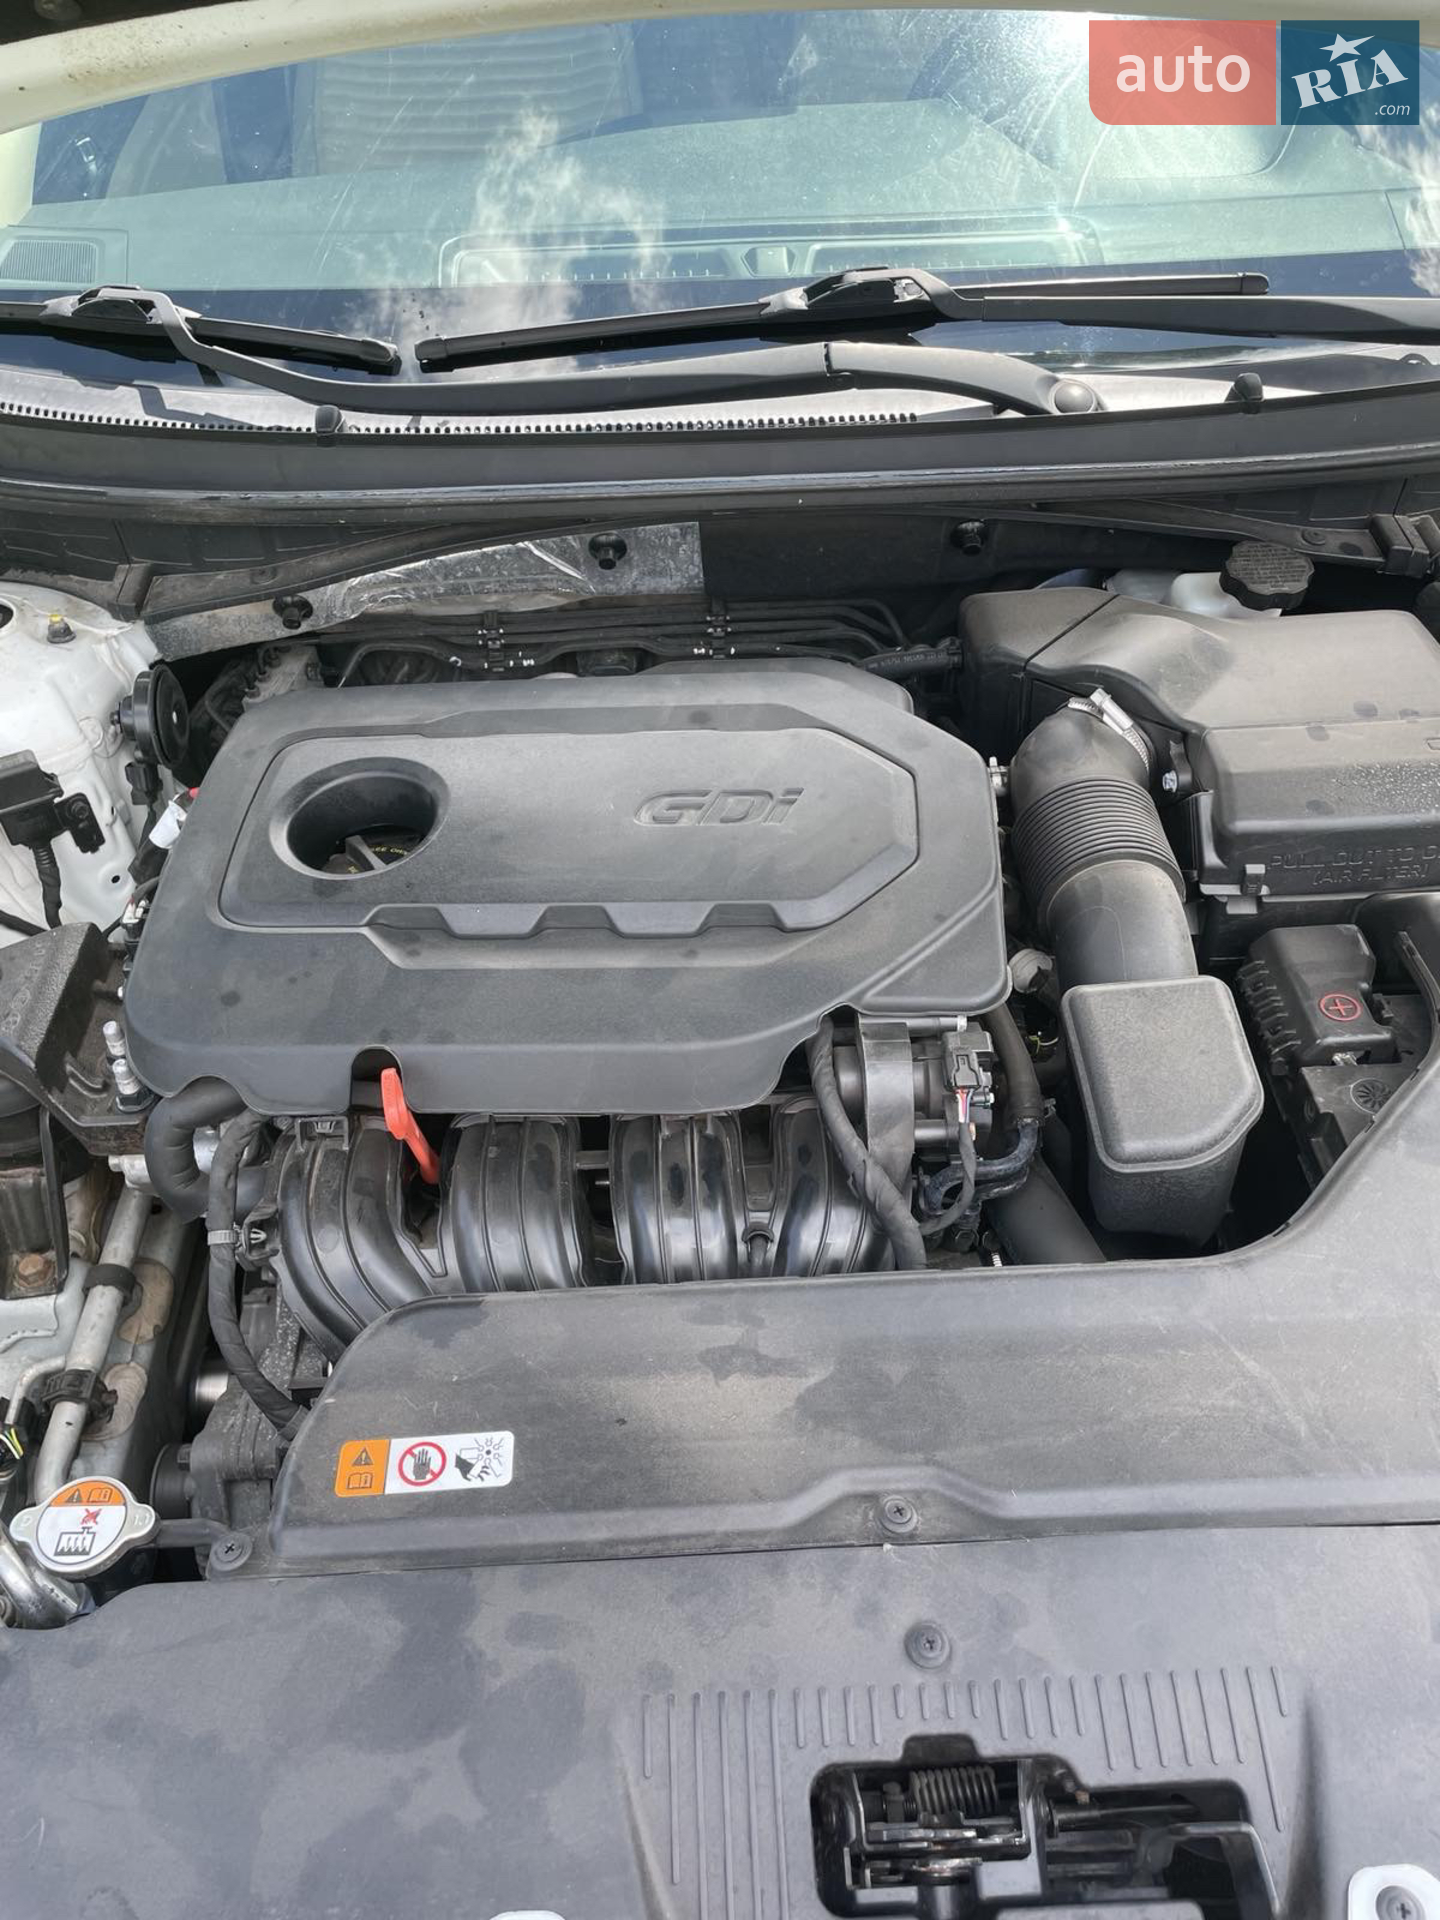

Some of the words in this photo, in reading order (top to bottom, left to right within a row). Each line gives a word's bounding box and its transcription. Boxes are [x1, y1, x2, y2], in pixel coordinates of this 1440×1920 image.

[633, 787, 805, 827] GDi
[1266, 852, 1326, 870] PULL
[1331, 849, 1382, 867] OUT
